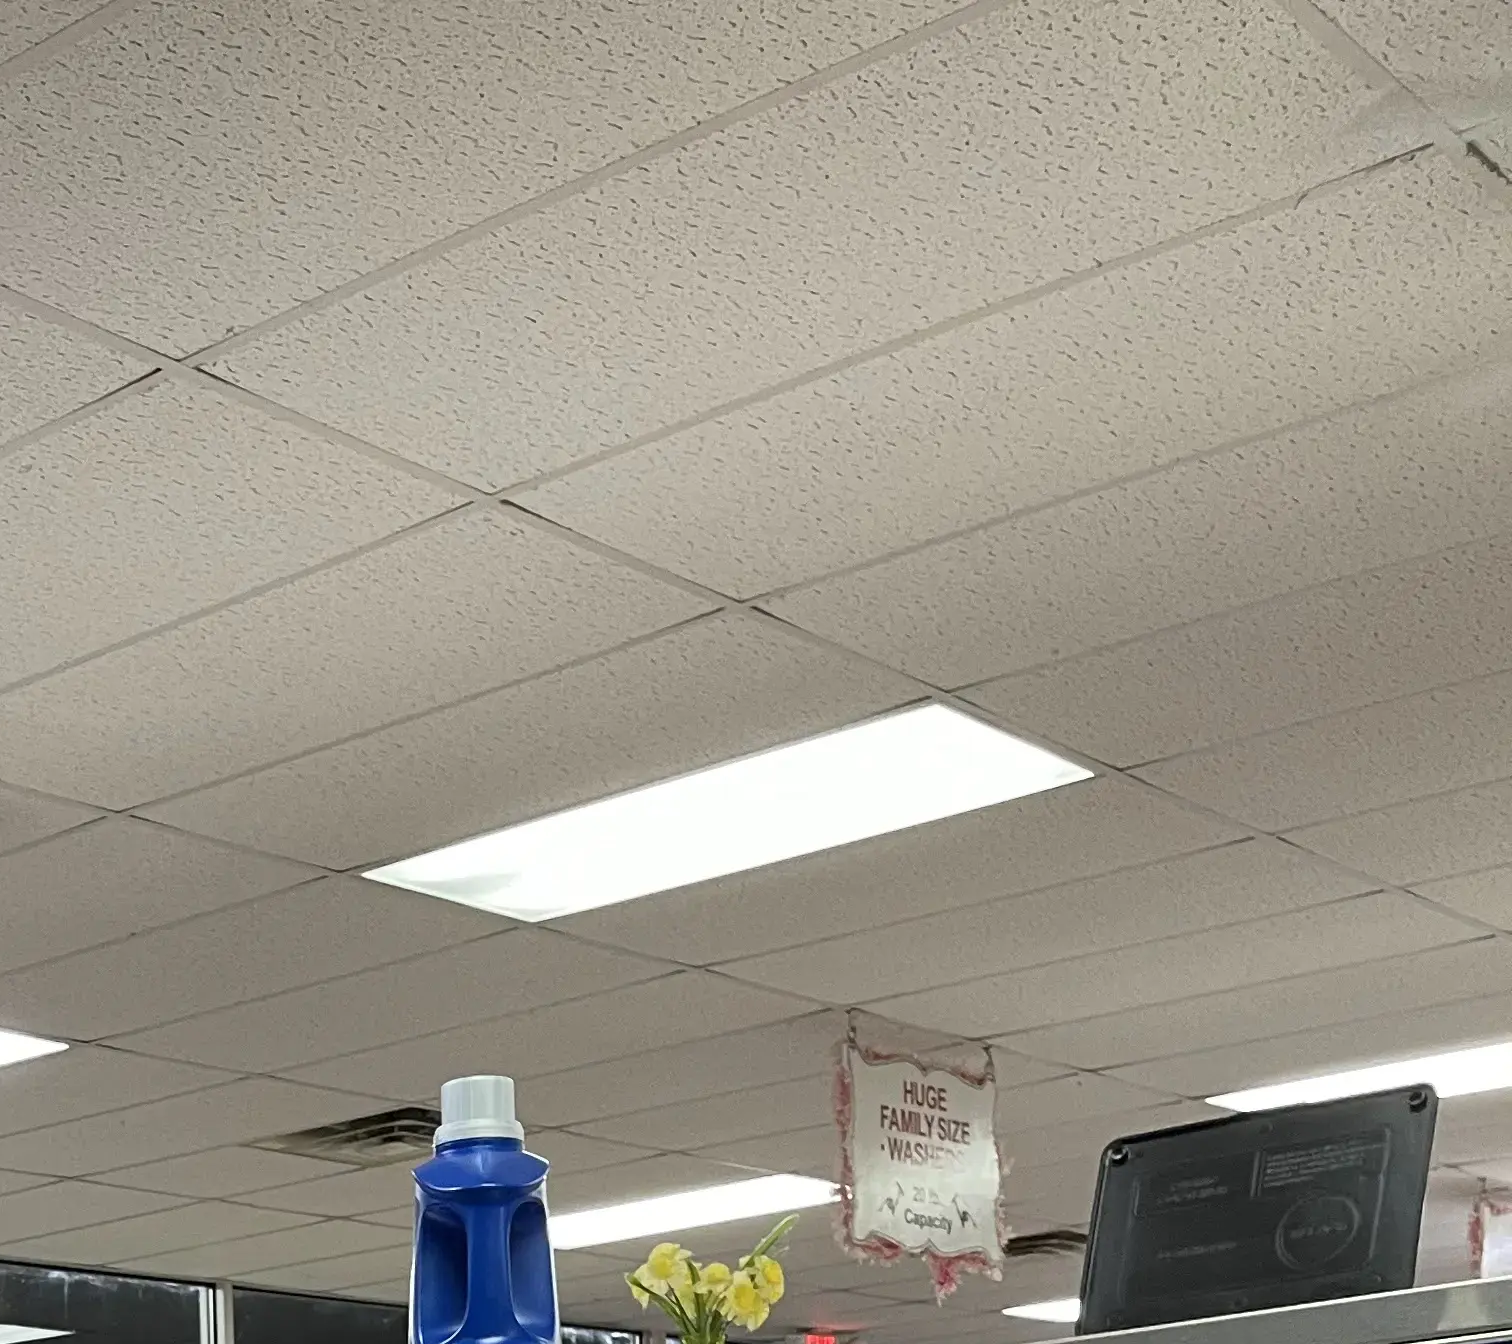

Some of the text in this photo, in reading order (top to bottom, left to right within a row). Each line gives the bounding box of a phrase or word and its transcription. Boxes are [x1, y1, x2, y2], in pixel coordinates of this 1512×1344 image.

[903, 1080, 947, 1112] HUGE
[879, 1104, 971, 1145] FAMILY SIZE
